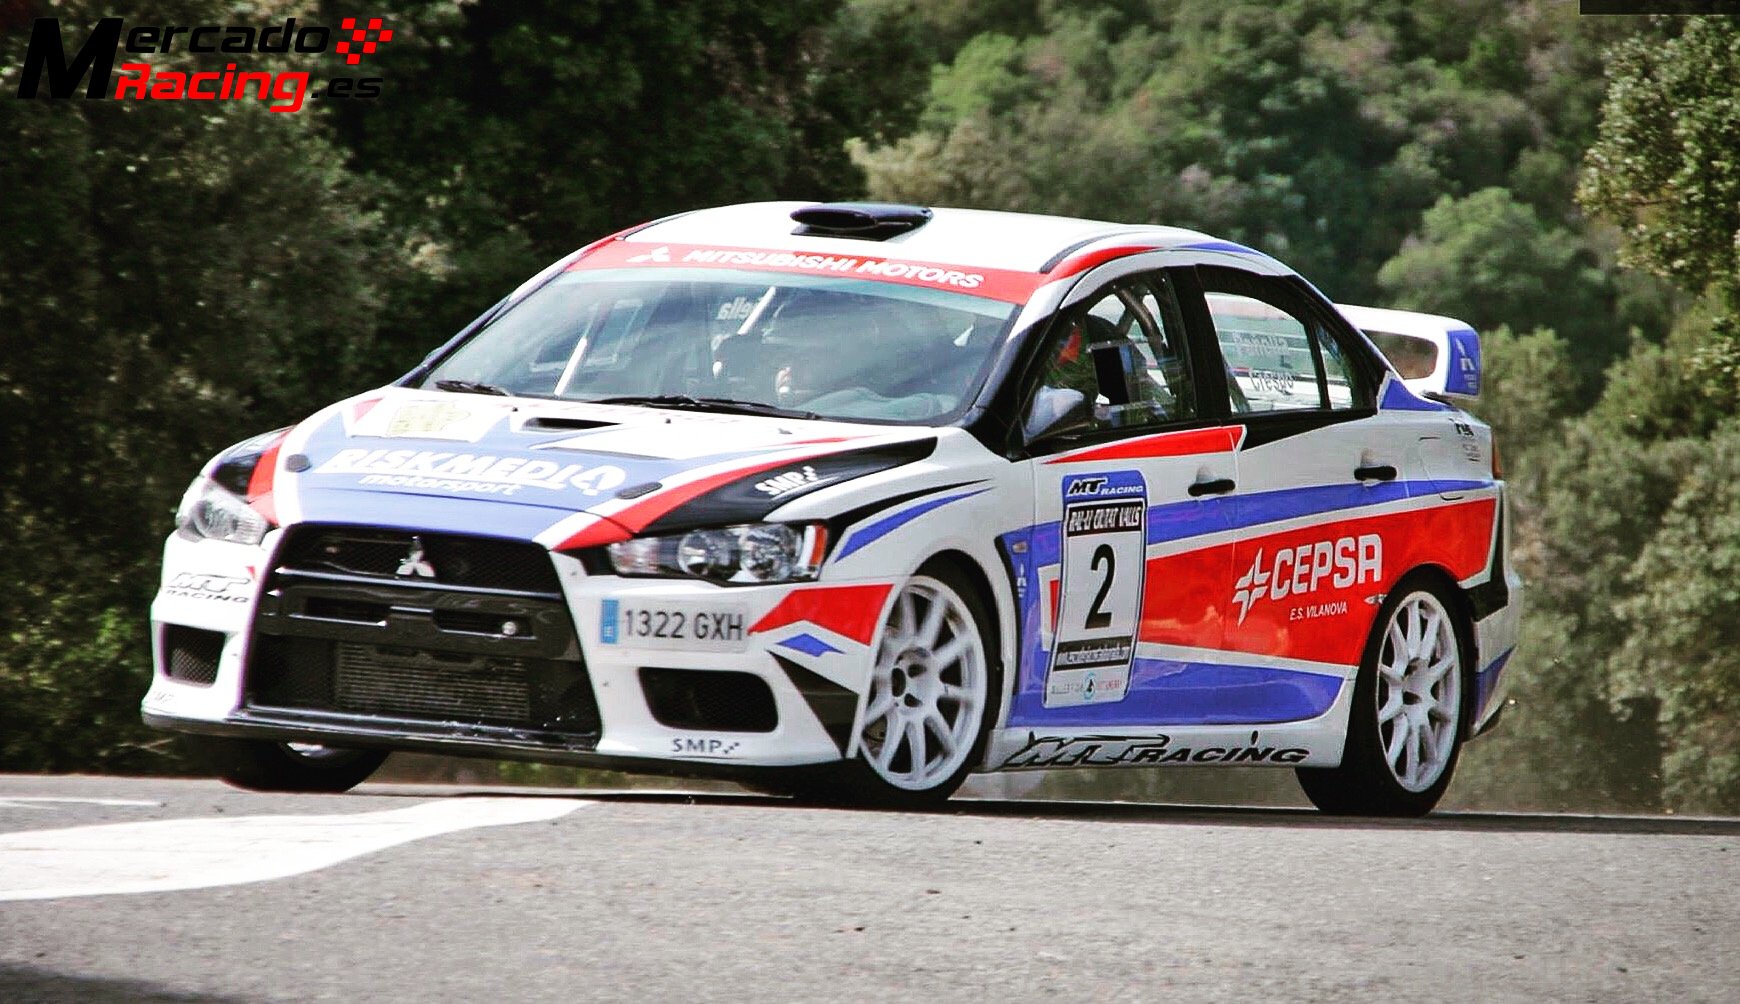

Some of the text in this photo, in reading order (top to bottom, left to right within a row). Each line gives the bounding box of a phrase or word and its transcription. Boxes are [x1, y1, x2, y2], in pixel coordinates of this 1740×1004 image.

[682, 249, 985, 288] MITSUBISHI MOTORS
[358, 474, 523, 496] motorsport
[1066, 476, 1144, 497] MT RACING
[1270, 533, 1383, 600] CEPSA
[1084, 543, 1116, 630] 2
[1306, 601, 1348, 619] VILANOVA
[625, 609, 743, 641] 1322 GXH
[671, 738, 723, 753] SMP
[1130, 746, 1311, 763] RACING
